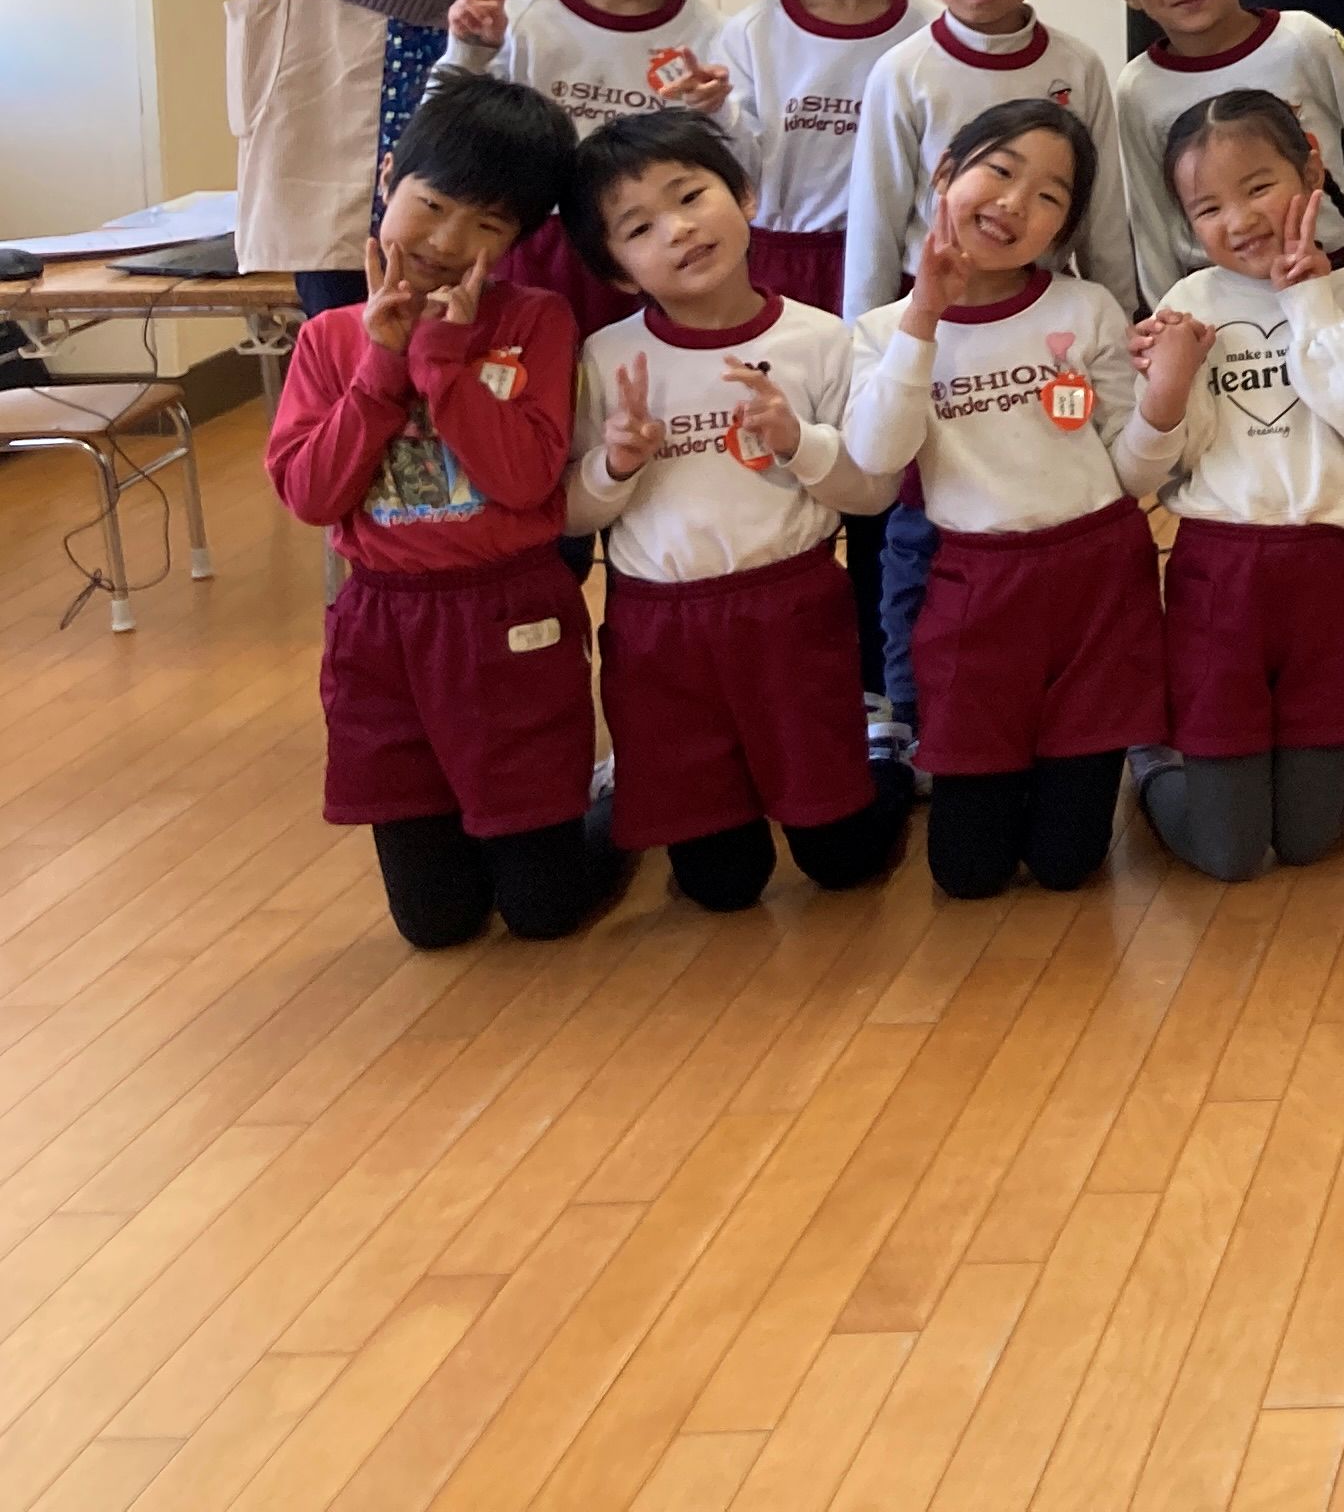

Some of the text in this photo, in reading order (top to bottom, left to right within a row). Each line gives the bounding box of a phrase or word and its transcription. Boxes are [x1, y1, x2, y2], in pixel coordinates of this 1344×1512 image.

[570, 82, 666, 112] SHION
[784, 114, 858, 135] kinderga
[1226, 346, 1290, 363] make a w
[950, 364, 1061, 396] SHION
[935, 386, 1043, 420] kindergart
[671, 411, 731, 435] SHI
